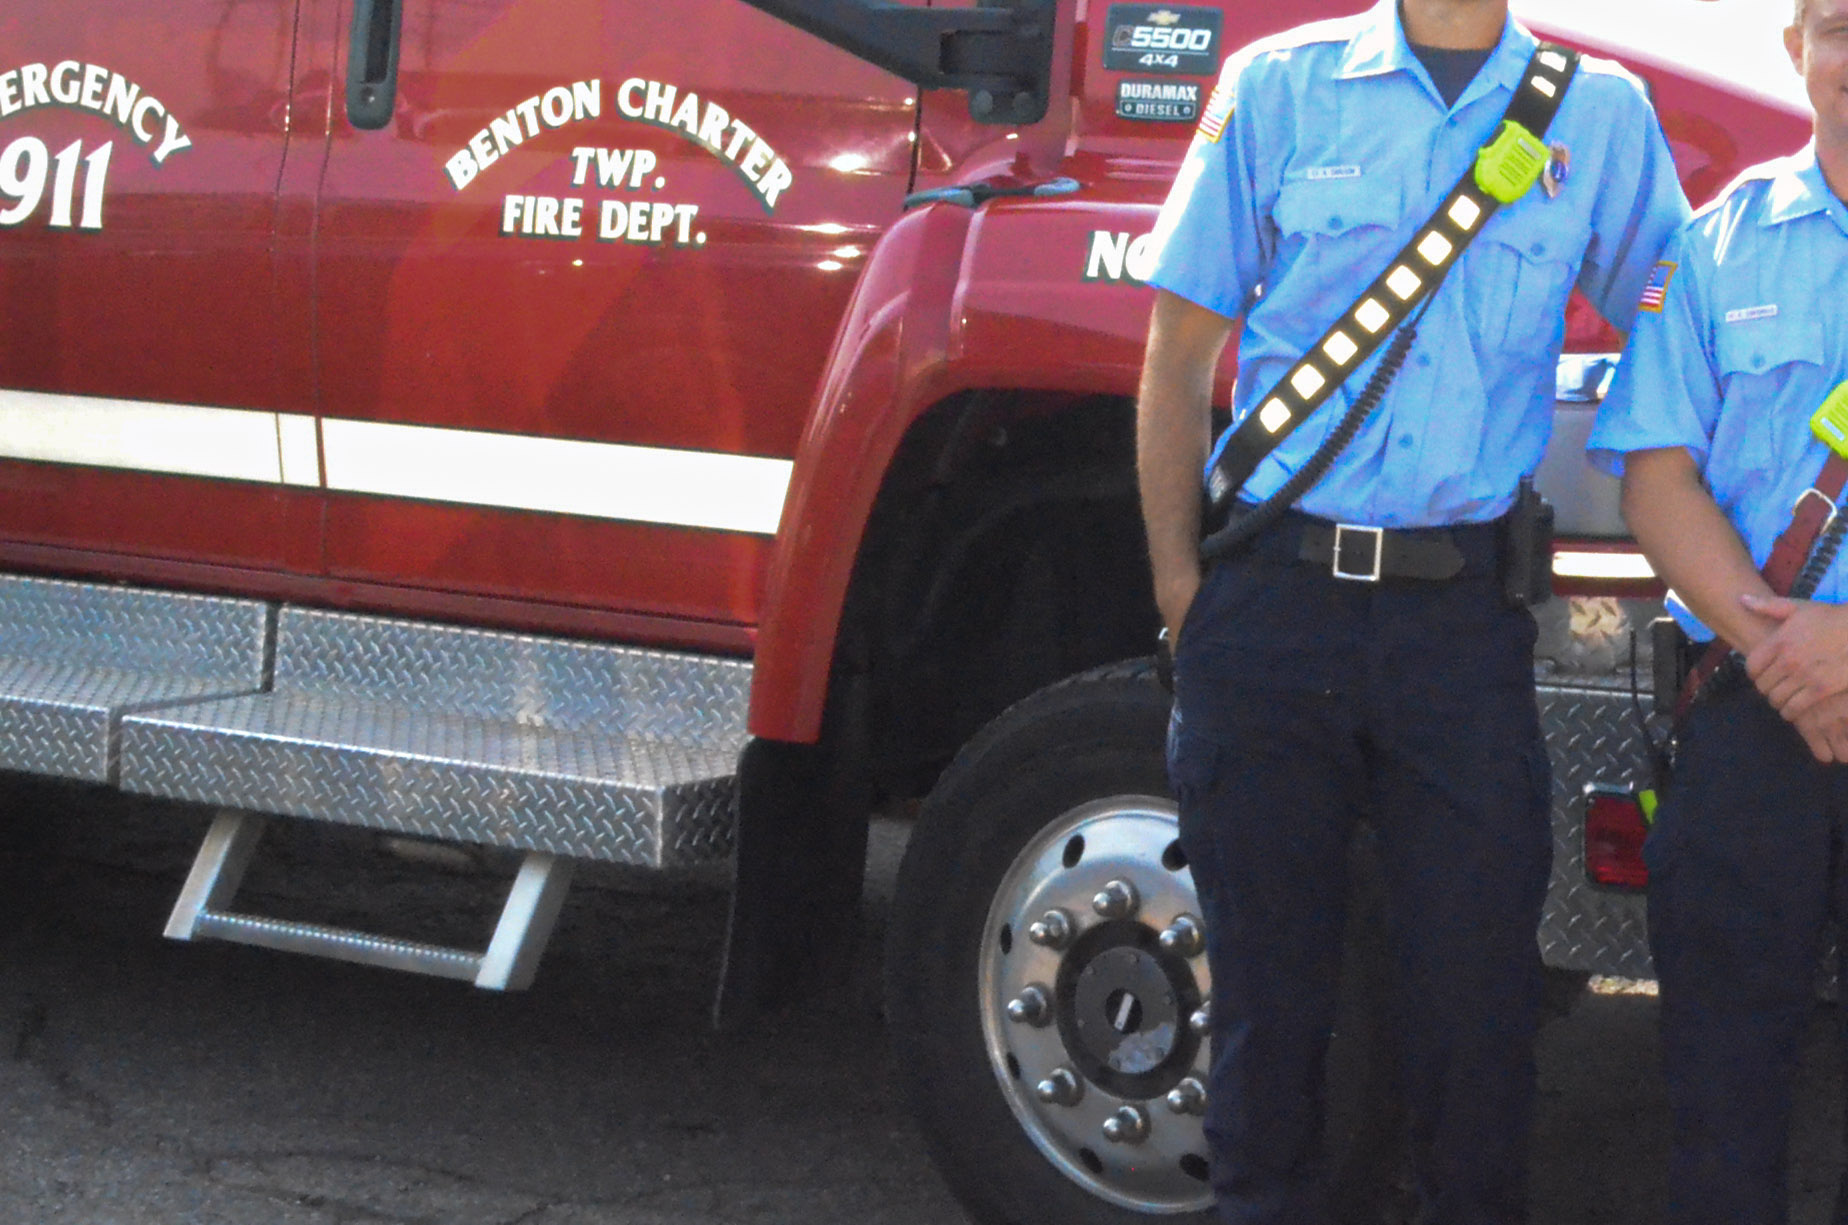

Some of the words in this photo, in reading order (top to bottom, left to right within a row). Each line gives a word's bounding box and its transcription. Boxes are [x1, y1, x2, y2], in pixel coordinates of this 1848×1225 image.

[1120, 83, 1198, 101] DURAMAX
[1135, 103, 1180, 117] DIESEL
[445, 78, 601, 191] BENTON
[617, 77, 793, 208] CHARTER
[0, 136, 113, 229] 911
[571, 146, 666, 189] TWP.
[502, 194, 584, 237] FIRE
[600, 199, 707, 244] DEPT.
